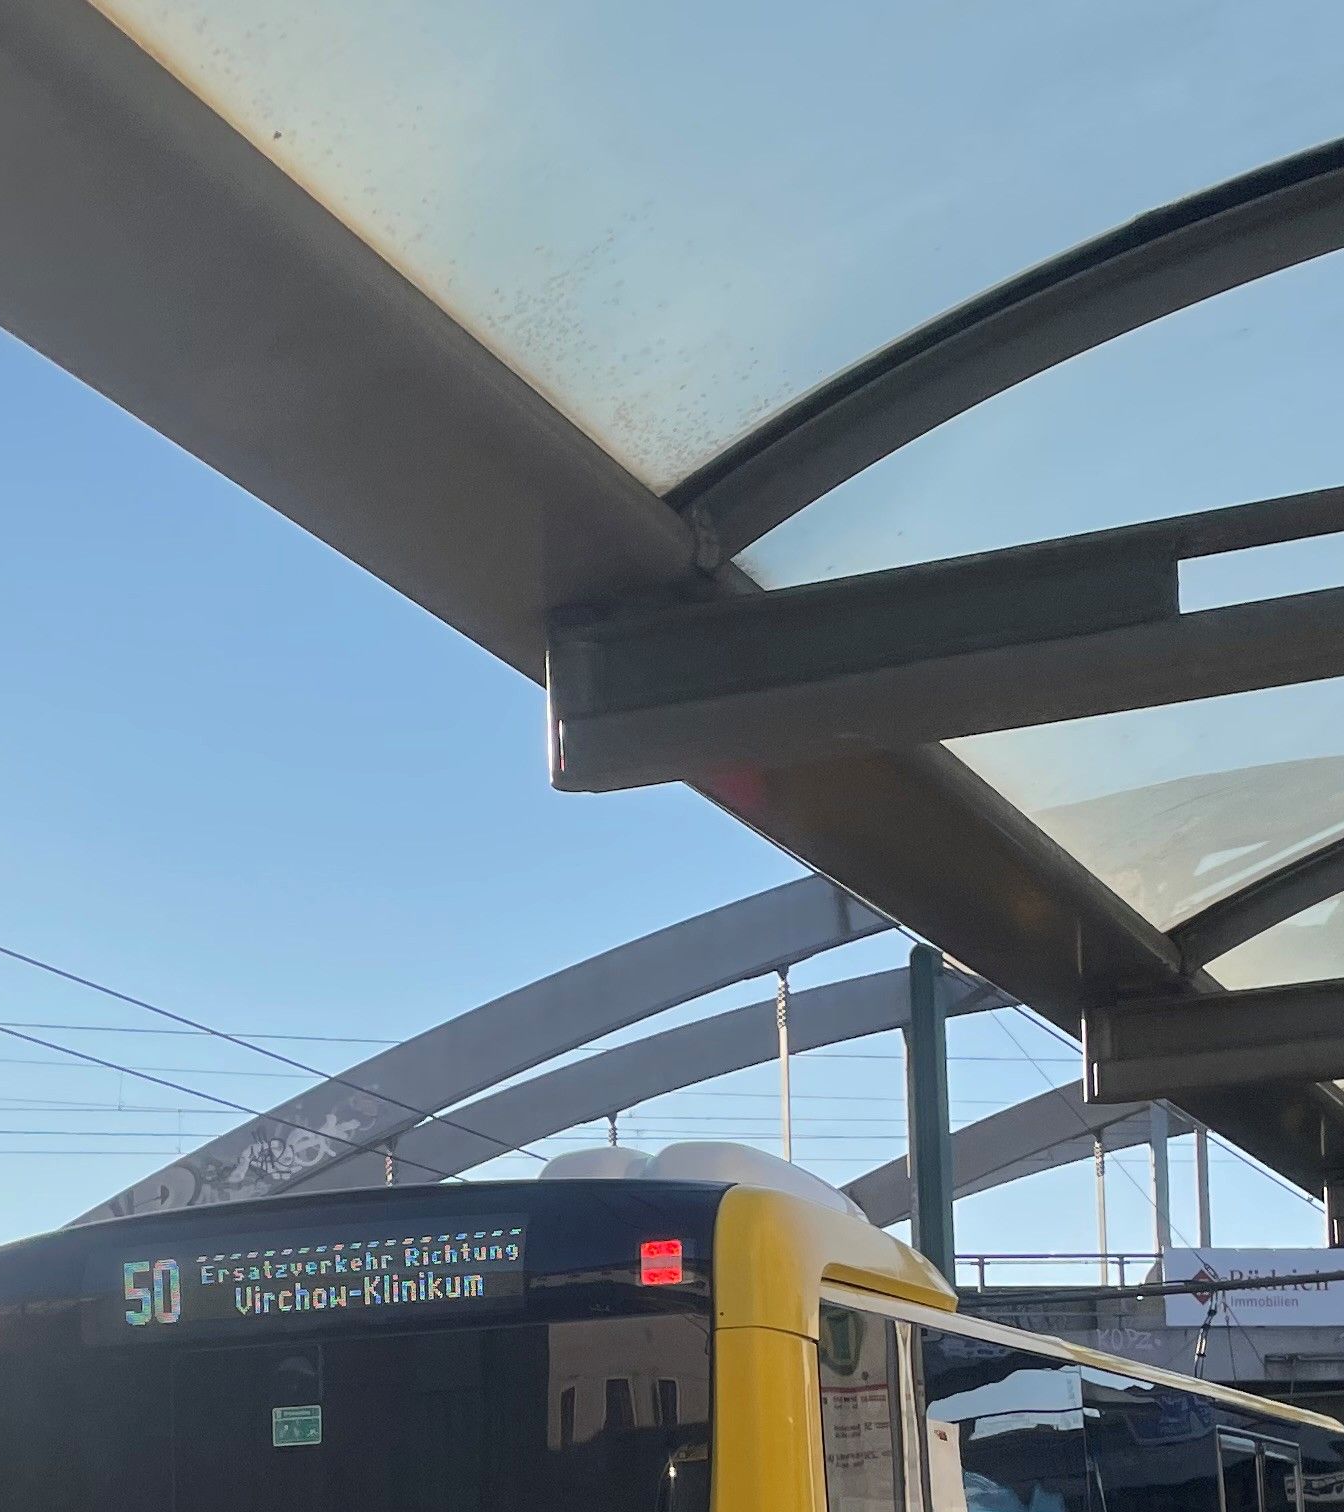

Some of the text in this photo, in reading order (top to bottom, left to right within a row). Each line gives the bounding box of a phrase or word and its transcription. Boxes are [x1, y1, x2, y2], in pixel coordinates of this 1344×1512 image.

[199, 1242, 520, 1286] Ersatzverkehr Richtung
[123, 1258, 182, 1326] 50
[234, 1271, 485, 1317] Virchow-Klinikum
[1230, 1295, 1299, 1308] Immobilien
